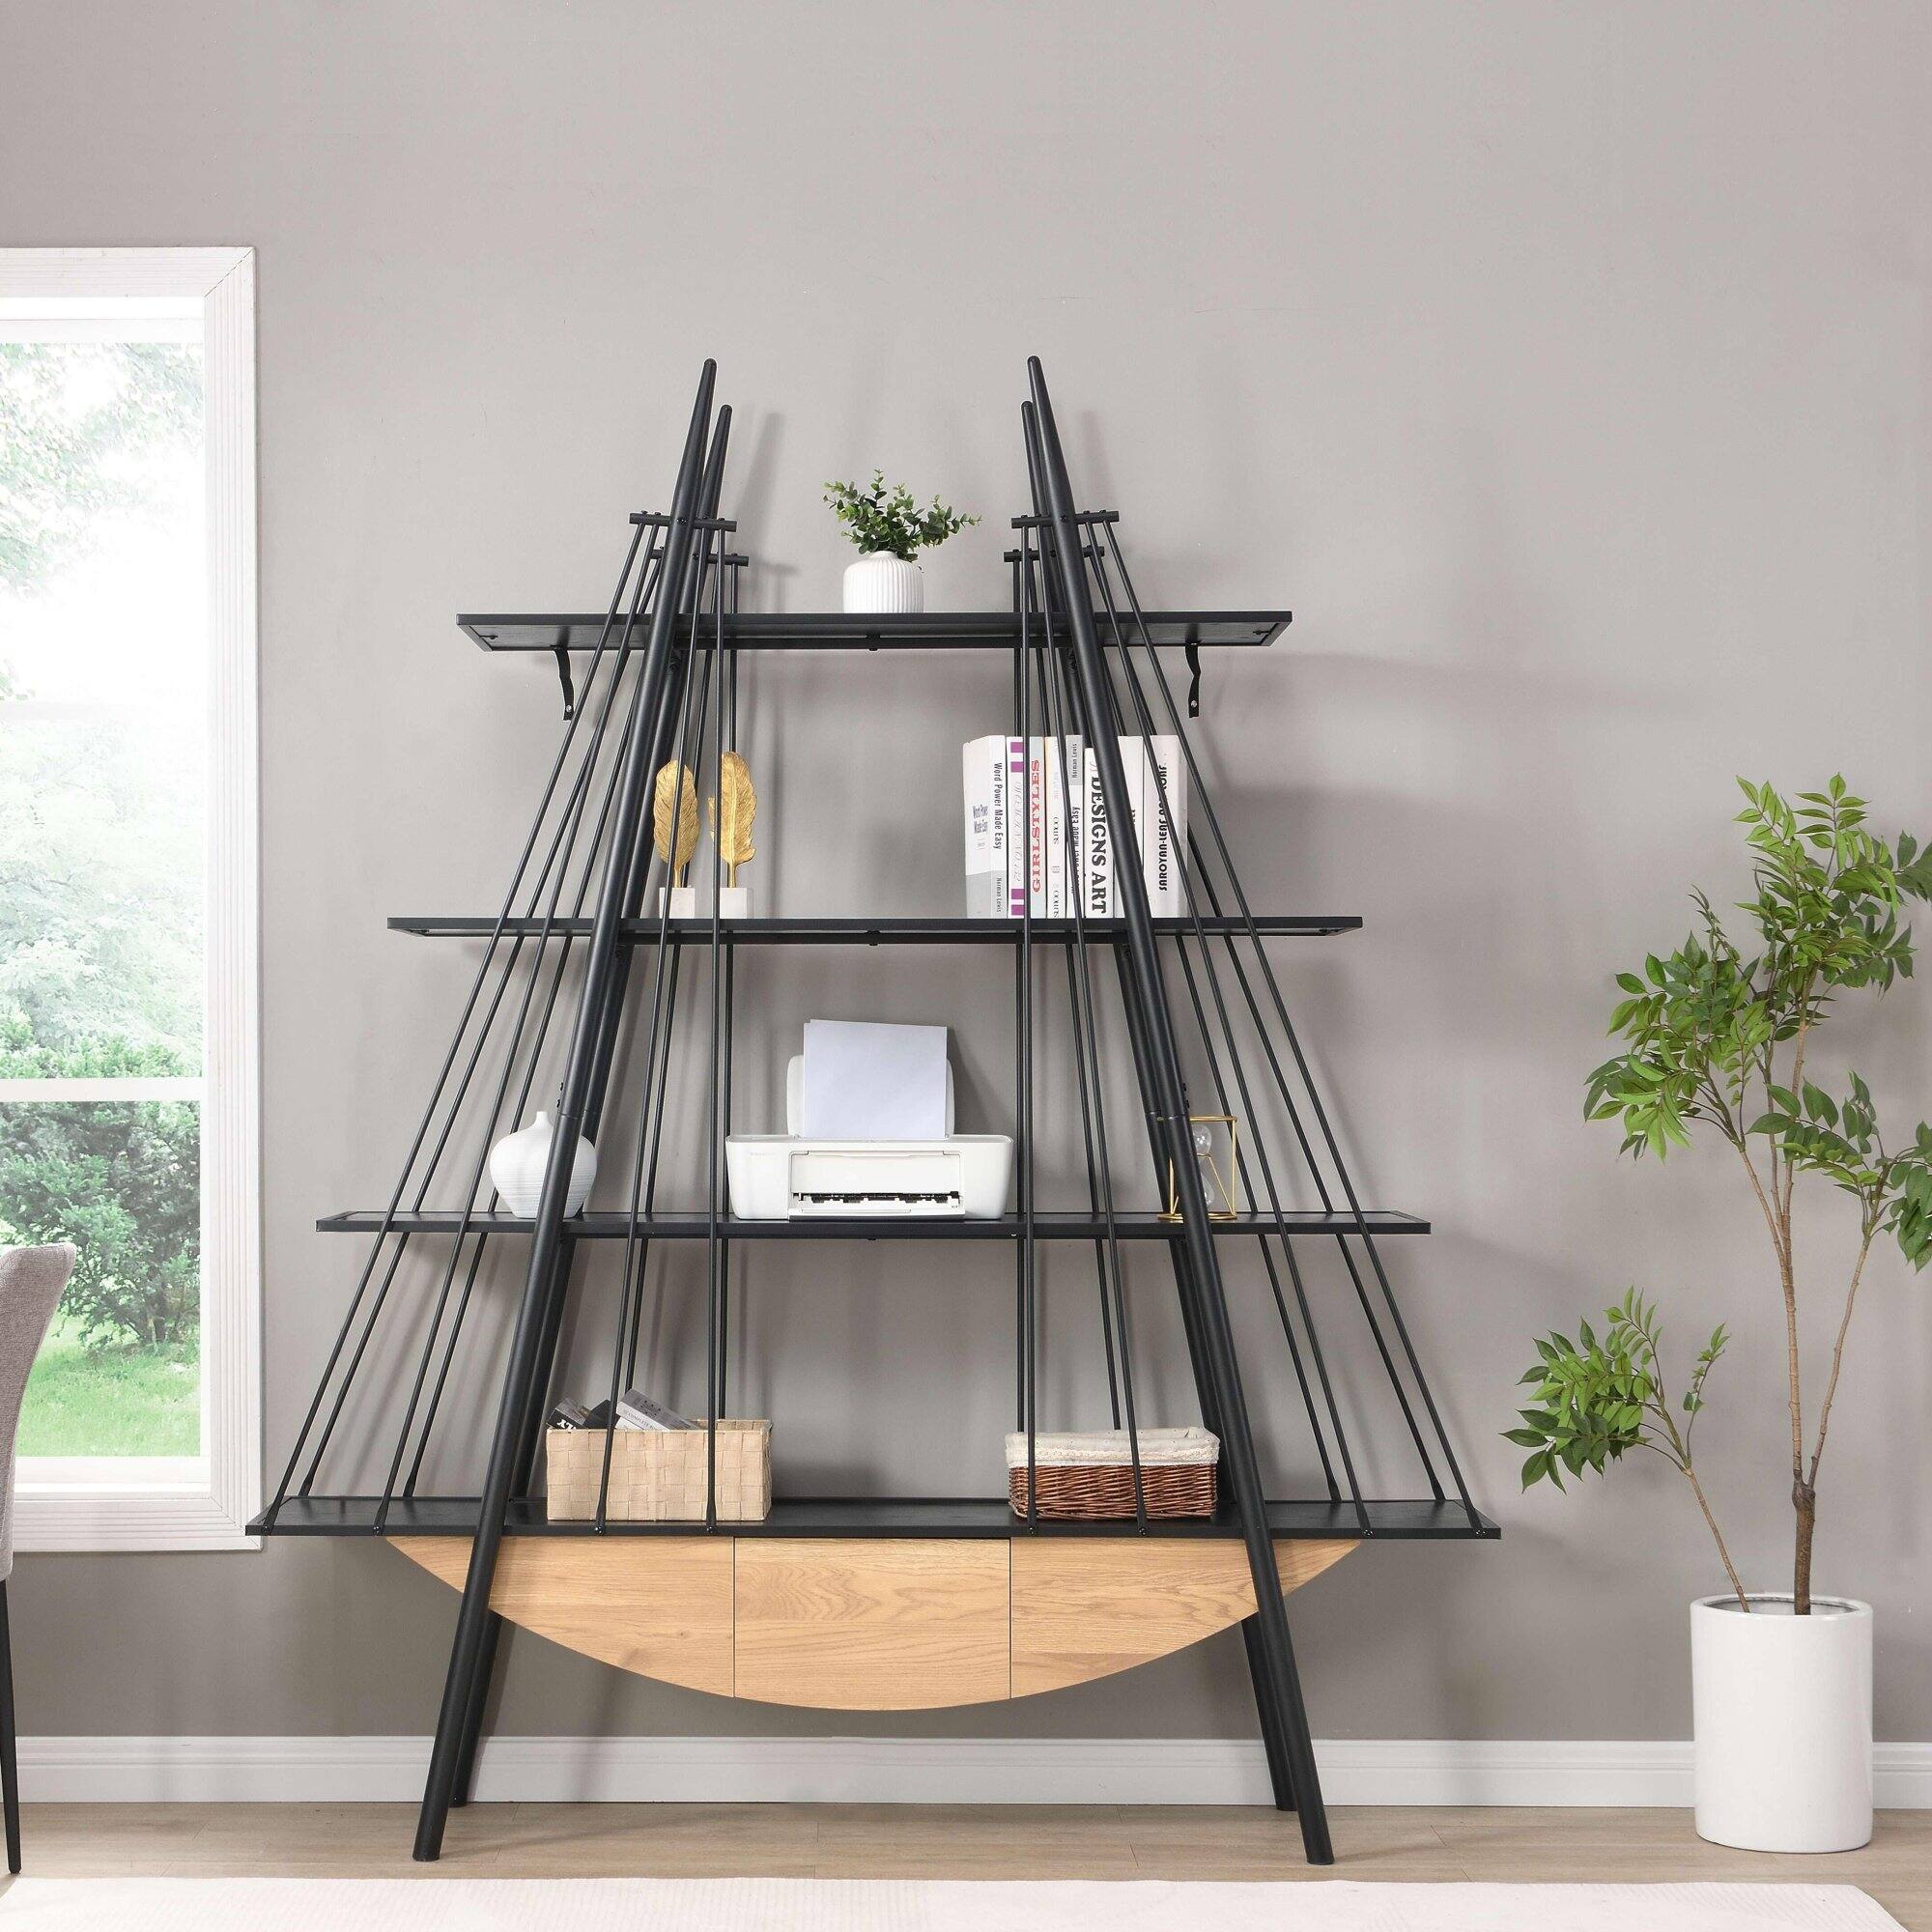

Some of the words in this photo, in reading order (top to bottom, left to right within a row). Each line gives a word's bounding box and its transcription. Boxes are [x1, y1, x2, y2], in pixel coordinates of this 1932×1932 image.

[994, 762, 1003, 782] Word
[994, 783, 1004, 807] Power
[995, 810, 1004, 830] Made
[1071, 806, 1081, 824] Easy
[1091, 777, 1107, 867] DESIGNS
[1031, 759, 1041, 894] GIRLSTYLES
[993, 831, 1004, 850] Easy
[1092, 871, 1107, 914] ART
